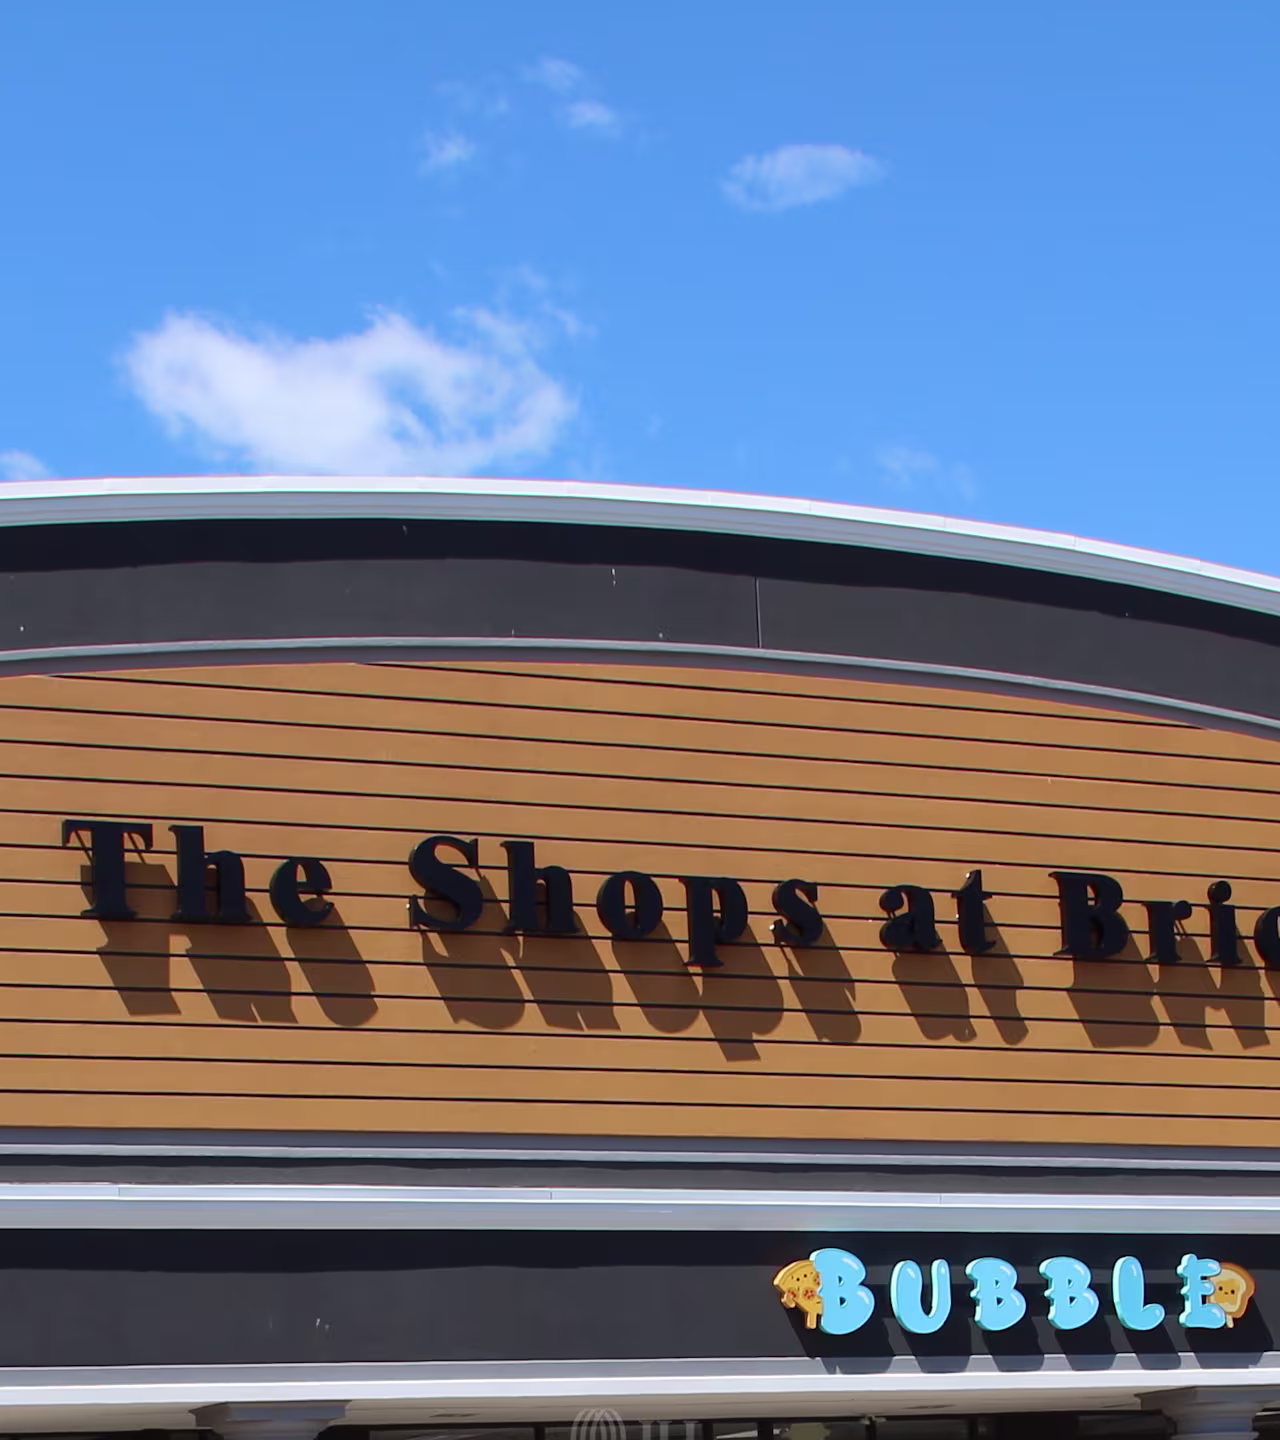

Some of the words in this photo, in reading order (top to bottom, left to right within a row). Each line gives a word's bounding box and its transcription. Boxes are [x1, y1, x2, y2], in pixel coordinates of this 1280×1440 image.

[62, 819, 336, 928] The
[407, 834, 825, 967] Shops
[877, 869, 996, 954] at
[812, 1247, 1227, 1336] BUBBLE
